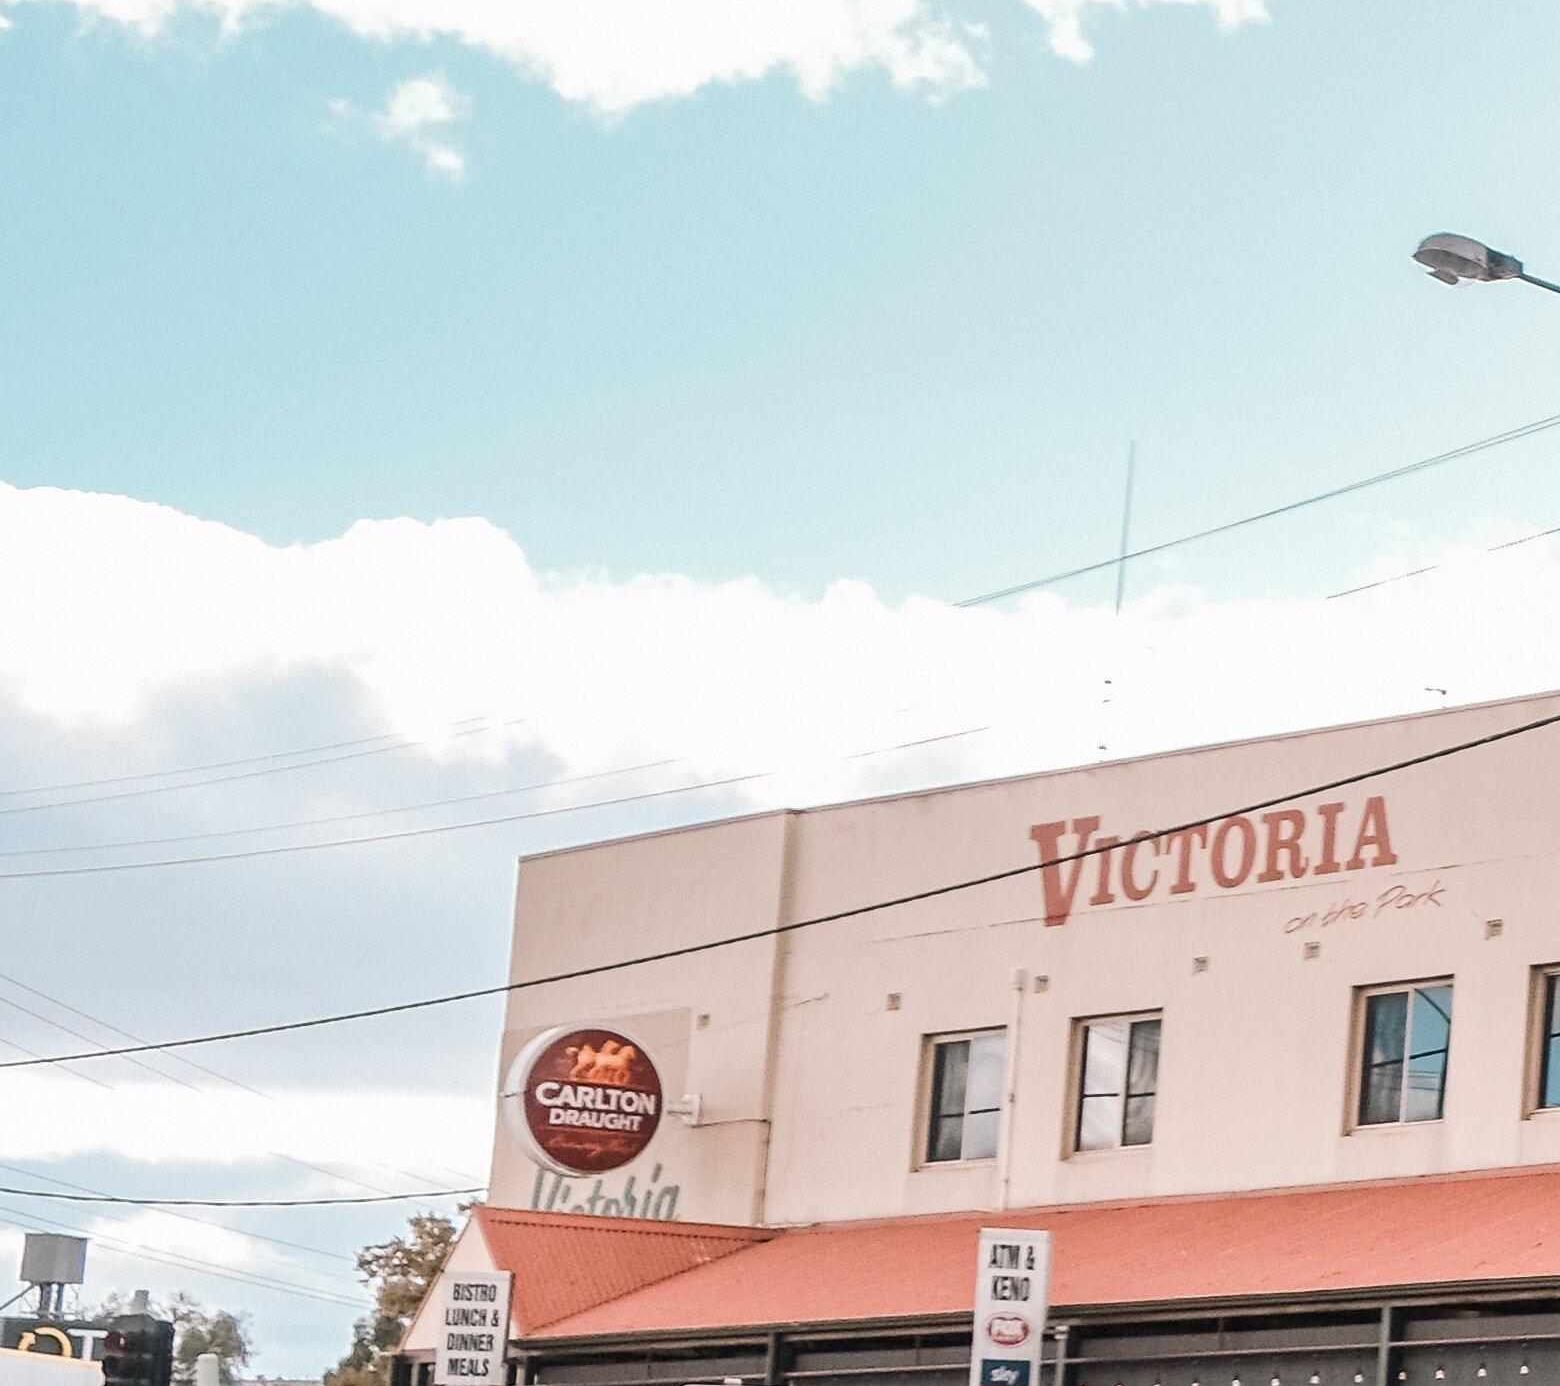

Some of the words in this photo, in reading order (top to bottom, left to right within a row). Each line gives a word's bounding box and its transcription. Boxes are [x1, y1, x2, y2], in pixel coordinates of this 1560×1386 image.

[1029, 795, 1399, 928] VICTORIA
[1284, 914, 1318, 935] on
[1321, 897, 1367, 928] the
[1377, 880, 1447, 910] Park
[534, 1080, 657, 1116] CARLTON
[549, 1108, 644, 1132] DRAUGHT
[989, 1244, 1021, 1270] ATM
[452, 1283, 497, 1303] BISTRO
[991, 1275, 1031, 1302] KENO
[445, 1308, 488, 1327] LUNCH
[490, 1310, 500, 1327] &
[446, 1333, 495, 1351] DINNER
[447, 1358, 490, 1377] MEALS
